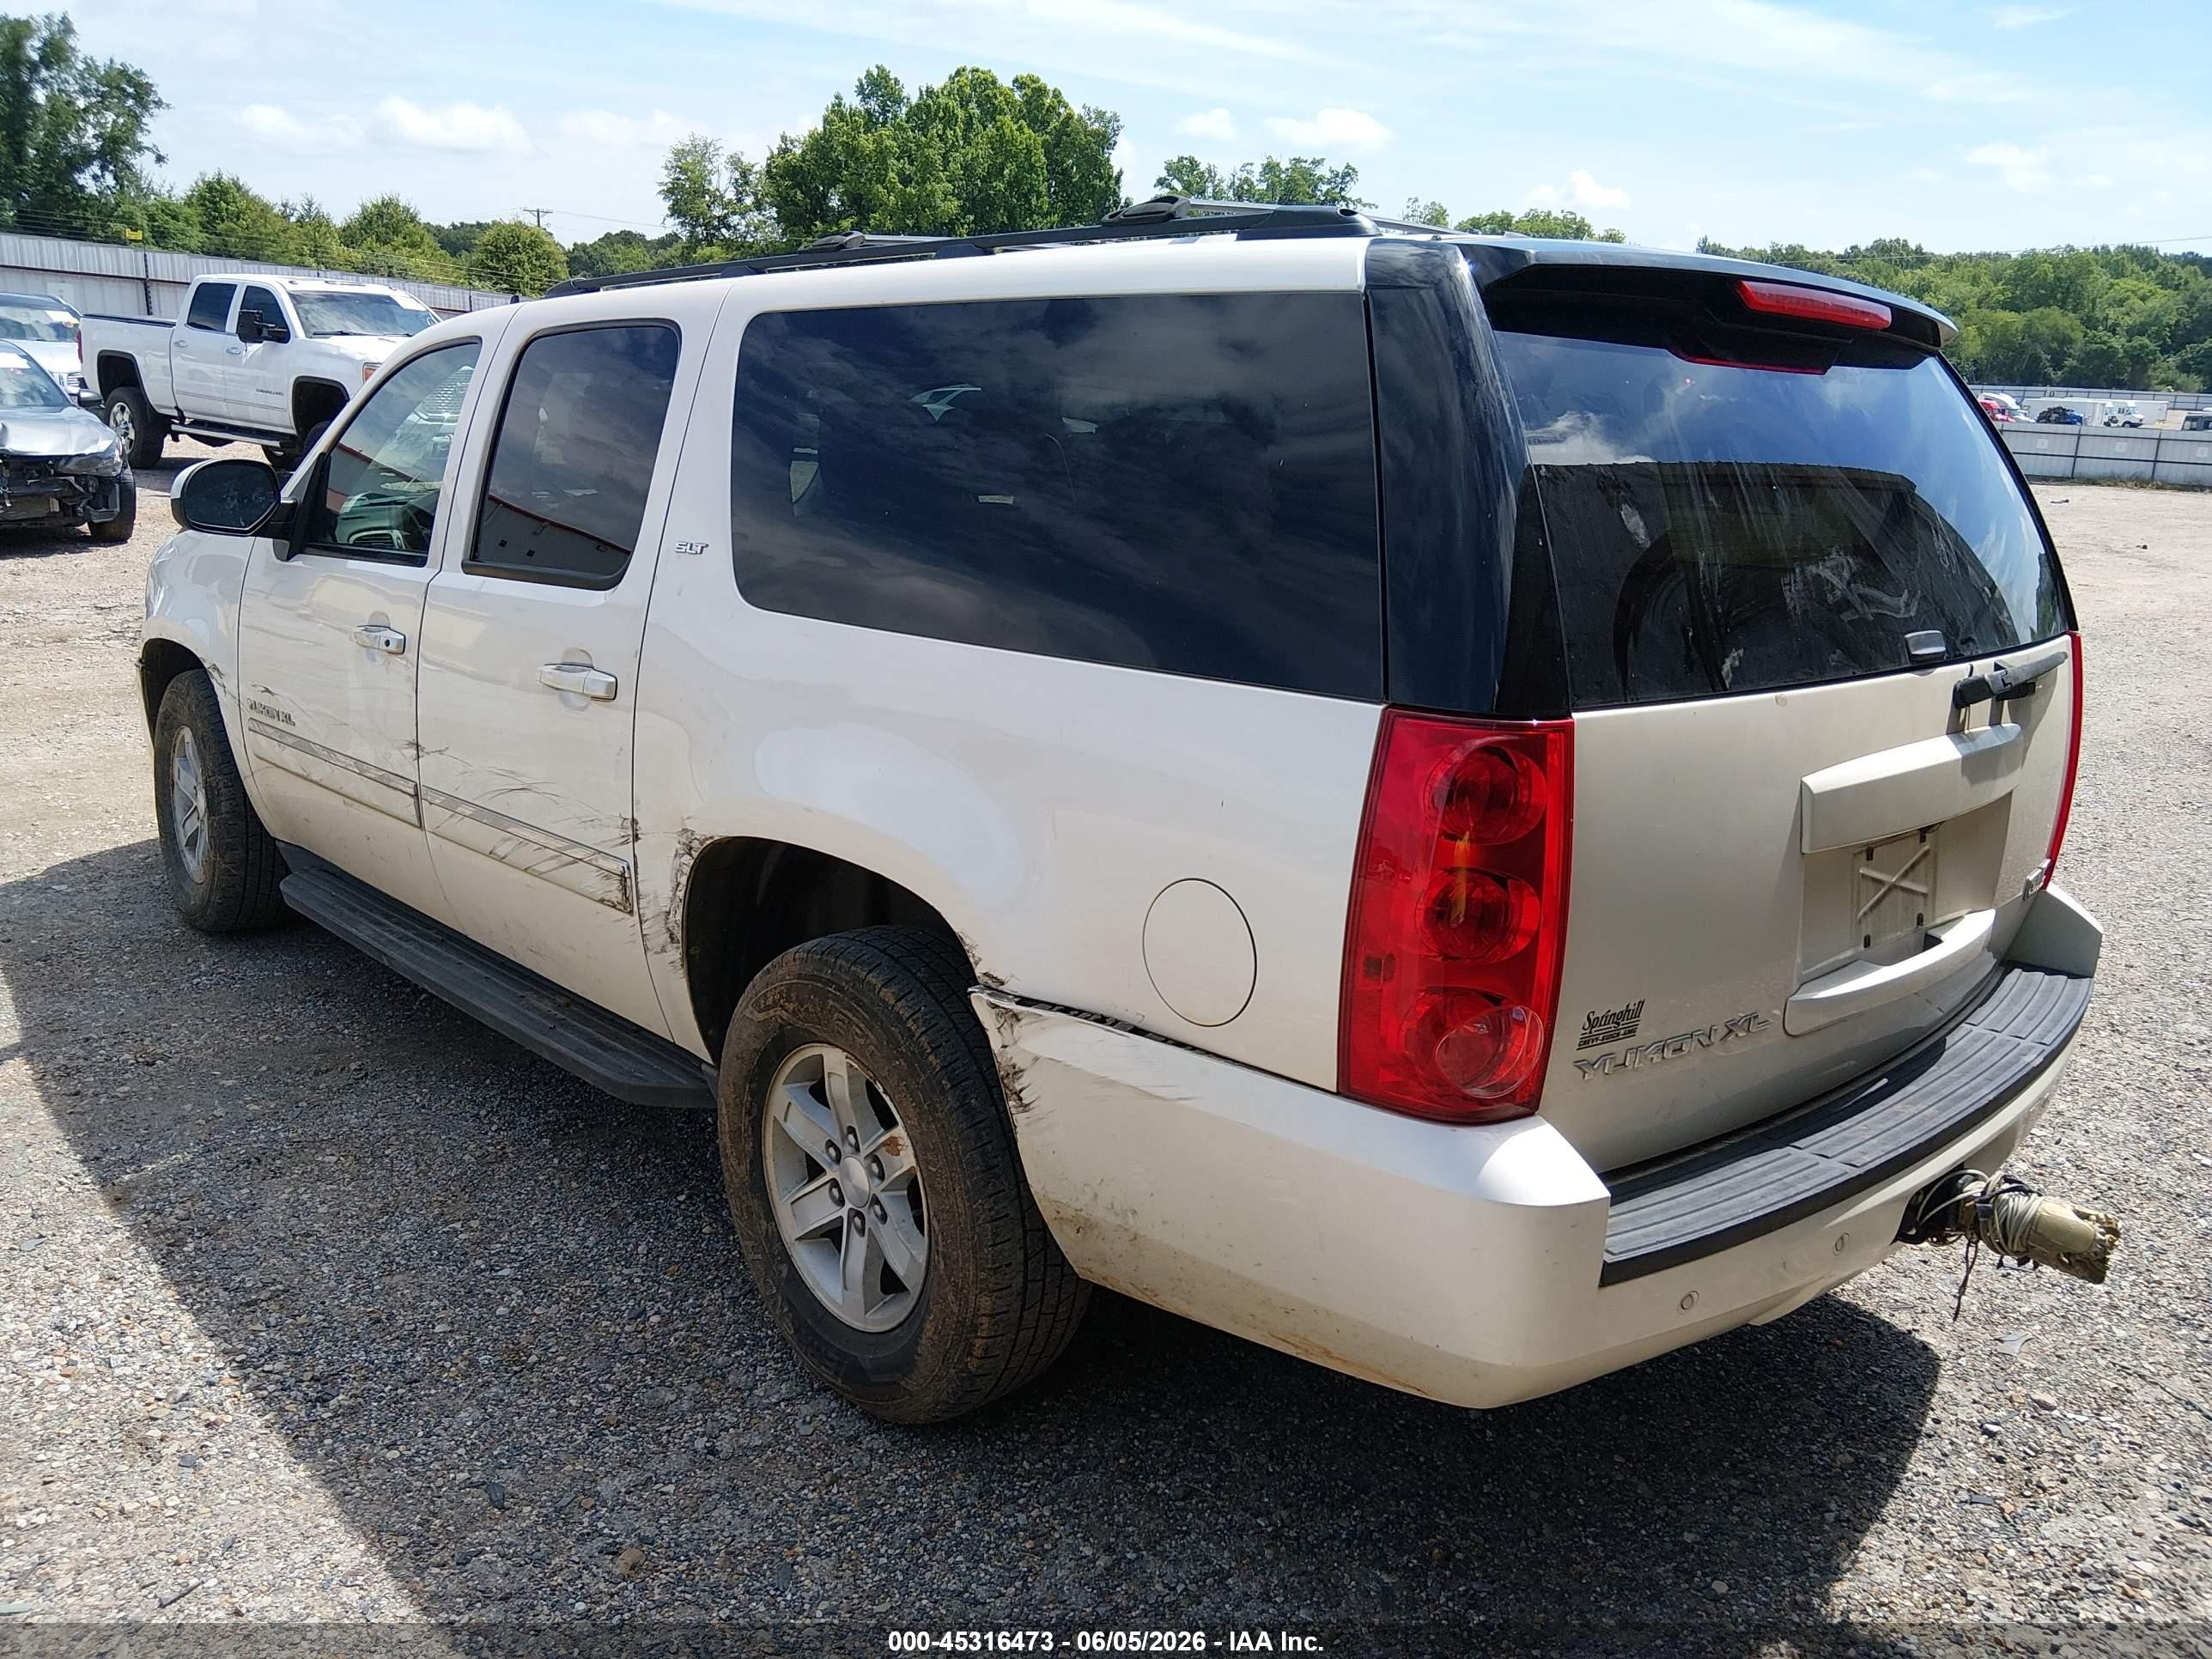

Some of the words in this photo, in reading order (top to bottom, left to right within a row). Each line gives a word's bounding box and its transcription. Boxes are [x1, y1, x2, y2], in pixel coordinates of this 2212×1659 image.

[674, 541, 709, 555] SLT
[1582, 999, 1645, 1034] Springhill
[1572, 1024, 1717, 1080] YUKON
[1719, 1012, 1772, 1042] XL
